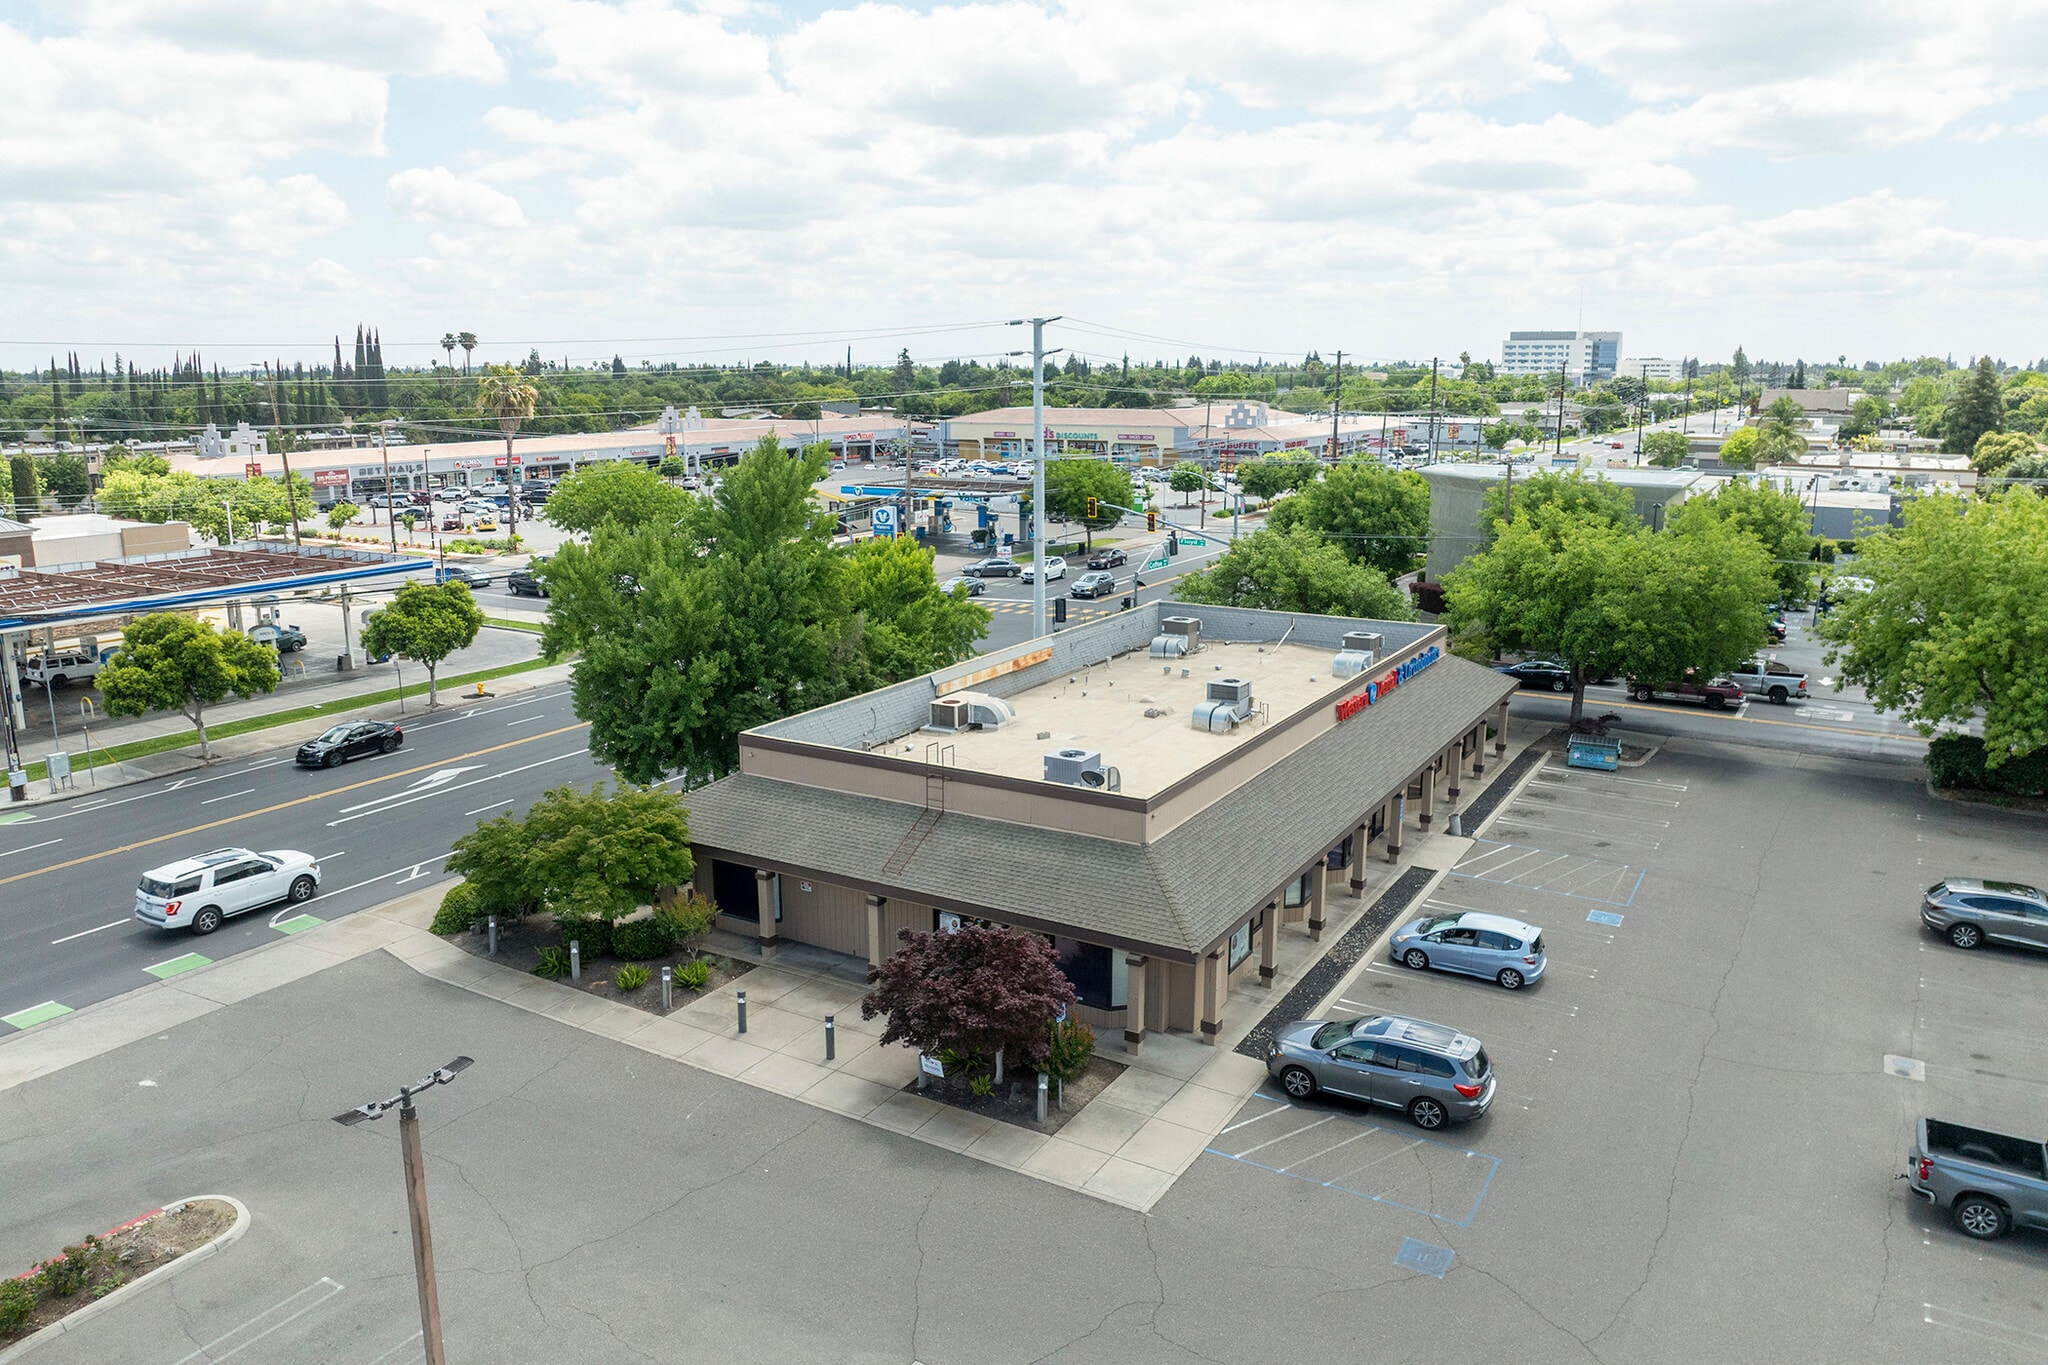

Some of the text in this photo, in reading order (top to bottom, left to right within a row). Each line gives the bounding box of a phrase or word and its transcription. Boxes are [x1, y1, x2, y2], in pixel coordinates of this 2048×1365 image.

[1227, 441, 1258, 449] BUFFET
[388, 464, 424, 474] NAILS
[1148, 561, 1163, 570] Coffee
